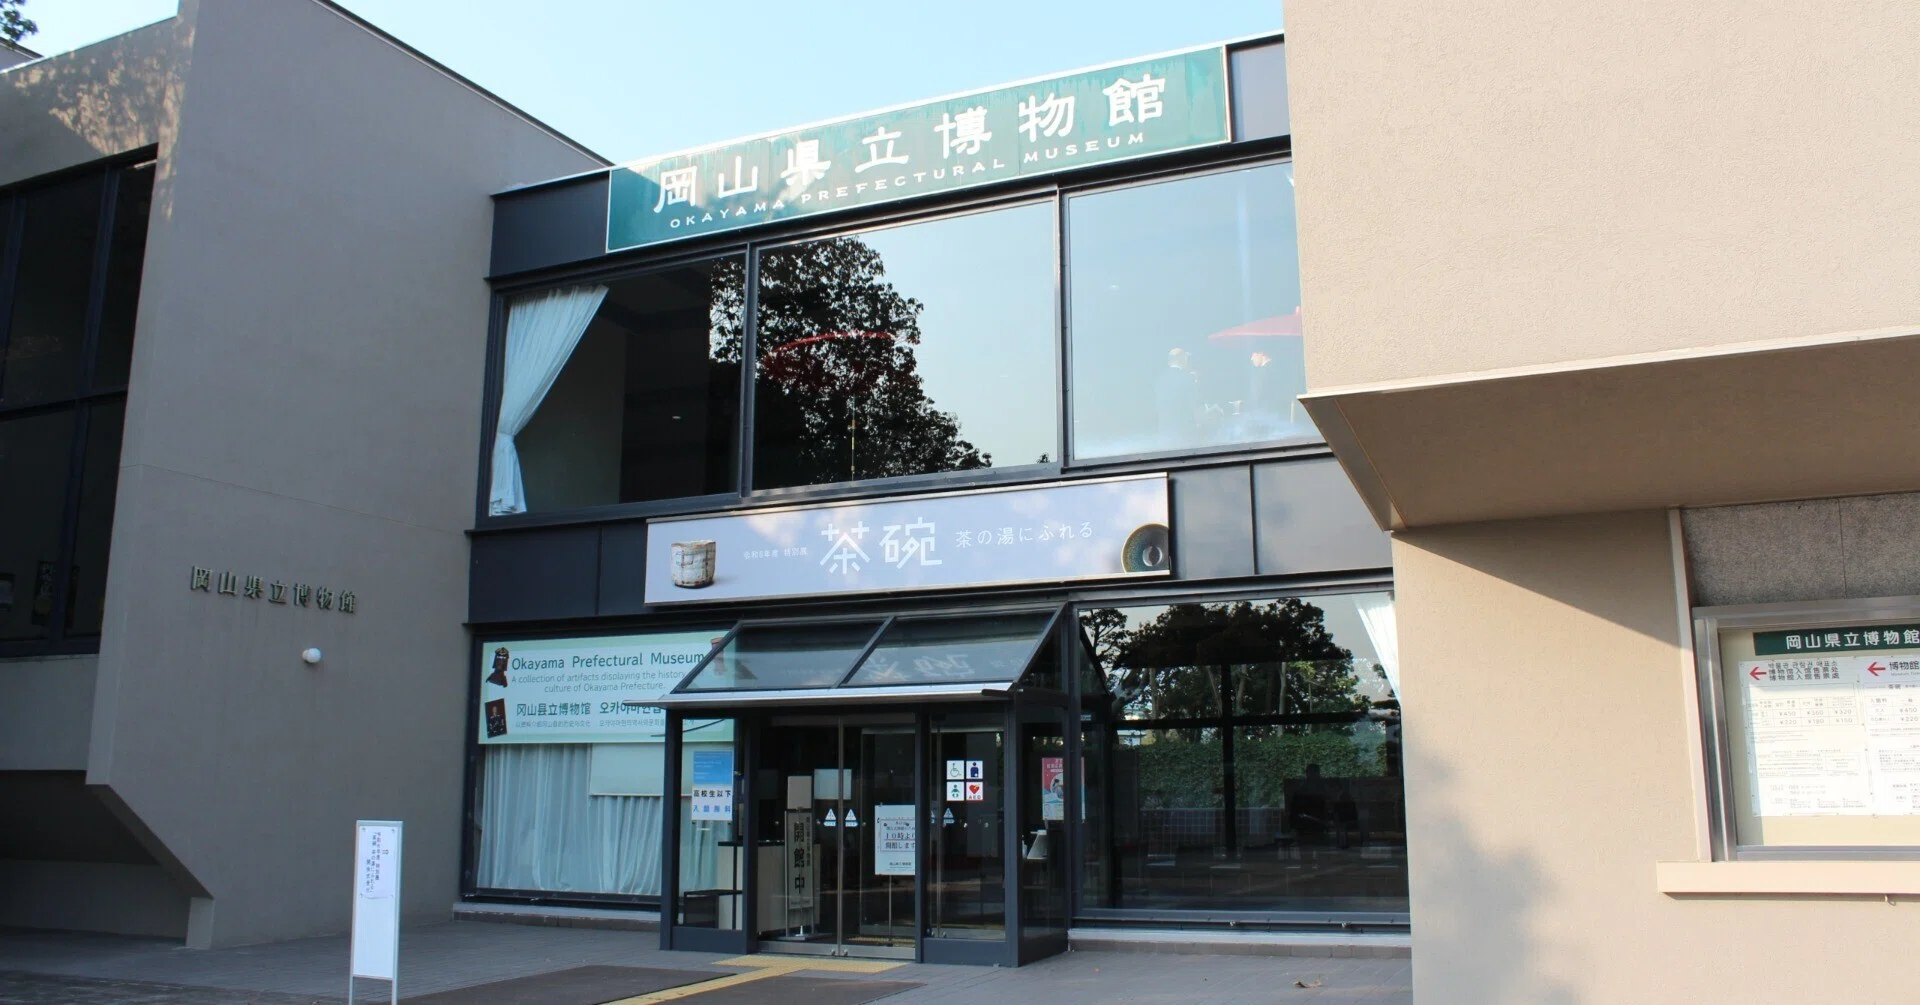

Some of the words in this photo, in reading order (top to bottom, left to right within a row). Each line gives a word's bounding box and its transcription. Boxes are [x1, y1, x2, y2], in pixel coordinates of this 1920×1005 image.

[653, 73, 1166, 214] 岡山県立博物館
[669, 198, 786, 229] OKAYAMA
[800, 157, 1005, 204] PREFECTURAL
[1023, 131, 1145, 164] MUSEUM
[819, 516, 943, 575] 茶碗
[955, 521, 1094, 549] 茶の湯にふれる
[191, 565, 356, 614] 岡山県立博物館
[1786, 629, 1920, 650] 岡山県立博物館
[511, 655, 565, 671] Okayama
[572, 652, 644, 668] Prefectural
[650, 651, 705, 665] Museum
[518, 675, 557, 684] collection
[558, 674, 566, 682] of
[567, 672, 600, 682] artifacts
[601, 671, 641, 682] displaying
[642, 670, 657, 679] the
[658, 669, 686, 681] history
[544, 685, 572, 693] culture
[573, 684, 582, 692] of
[583, 683, 619, 693] Okayama
[620, 681, 666, 691] Prefecture.
[516, 702, 591, 717] 冈山县立博物馆
[693, 789, 731, 797] 高校生以下
[794, 822, 805, 894] 開館中
